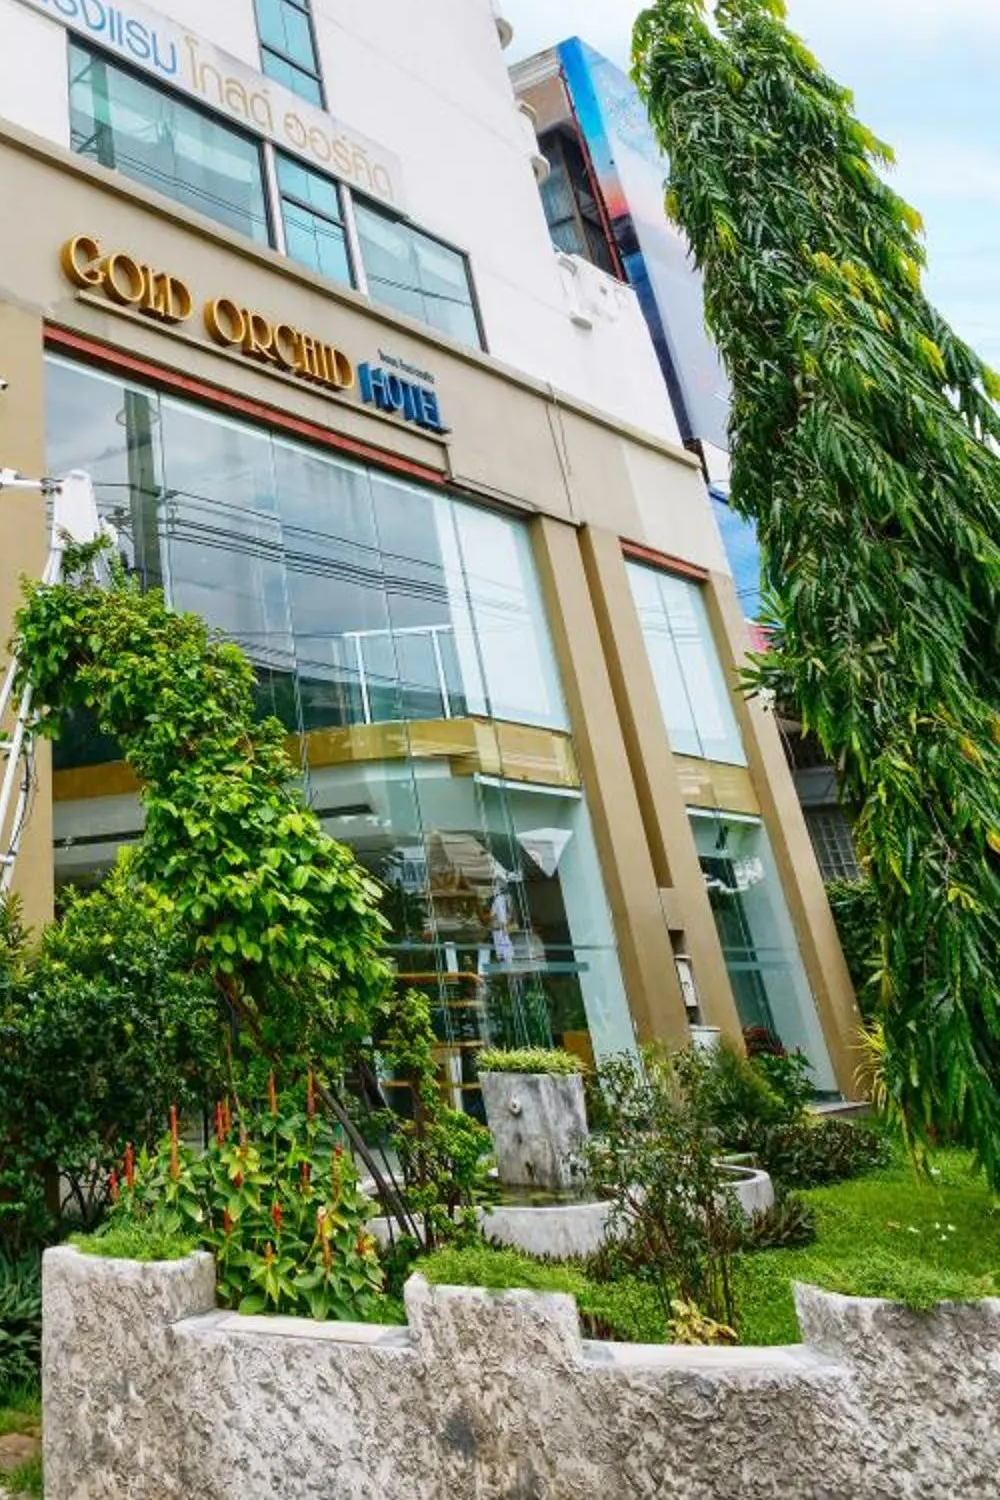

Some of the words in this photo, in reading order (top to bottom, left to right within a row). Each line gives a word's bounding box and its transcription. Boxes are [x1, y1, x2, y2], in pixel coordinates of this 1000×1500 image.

[60, 234, 193, 324] GOLD
[204, 298, 355, 390] ORCHID
[358, 362, 442, 431] HOTEL
